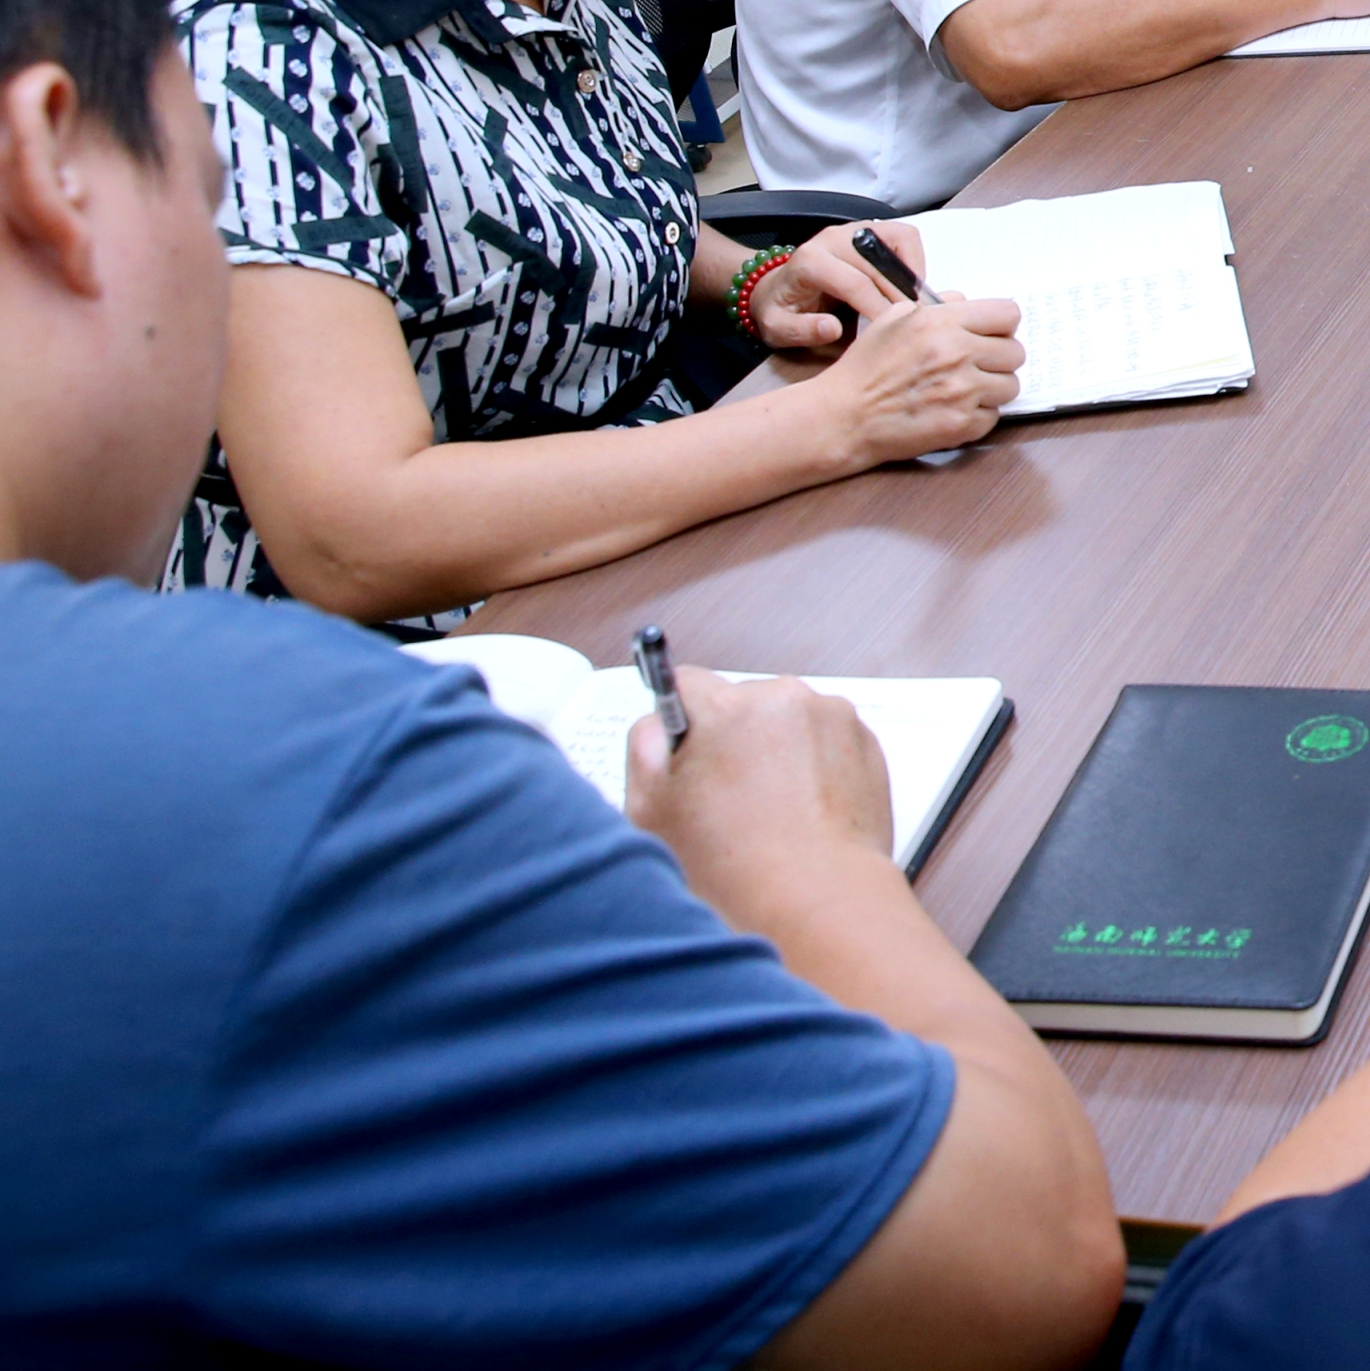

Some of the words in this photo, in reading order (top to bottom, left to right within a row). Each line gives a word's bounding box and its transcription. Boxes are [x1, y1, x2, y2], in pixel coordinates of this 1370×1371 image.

[1060, 921, 1252, 950] 海南师范大学
